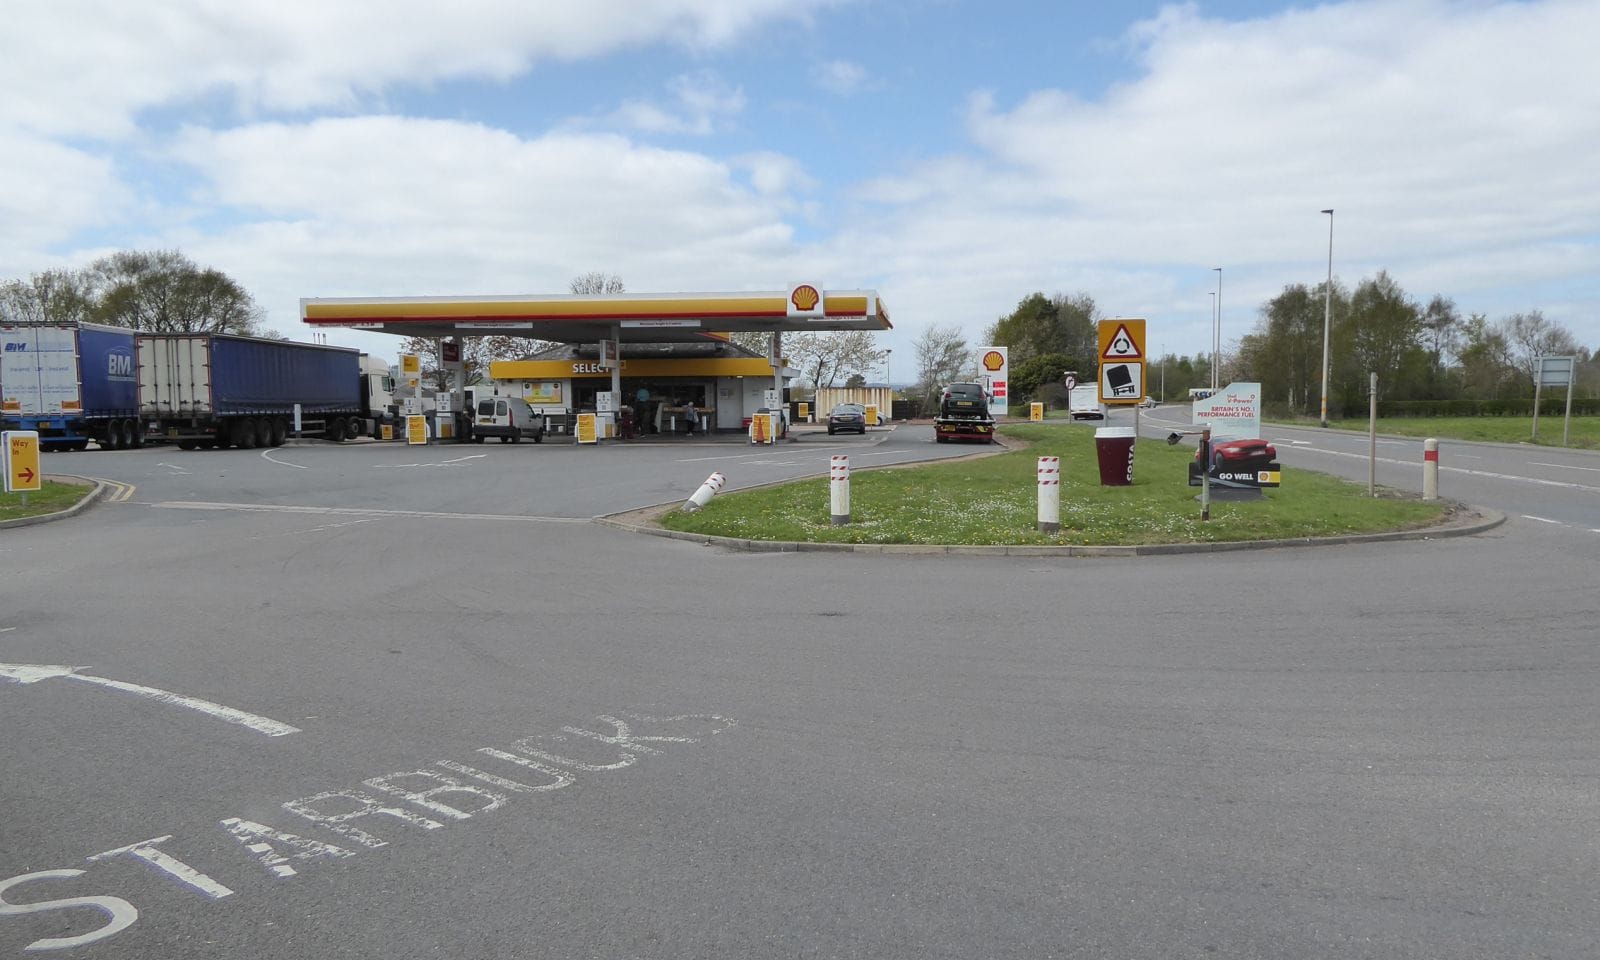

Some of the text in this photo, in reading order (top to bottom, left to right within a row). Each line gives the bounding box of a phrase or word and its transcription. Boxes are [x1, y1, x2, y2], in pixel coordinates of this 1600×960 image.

[4, 343, 27, 351] BM
[108, 354, 131, 375] BM
[11, 439, 29, 448] Way
[12, 448, 20, 456] In
[1126, 445, 1134, 481] COSTA
